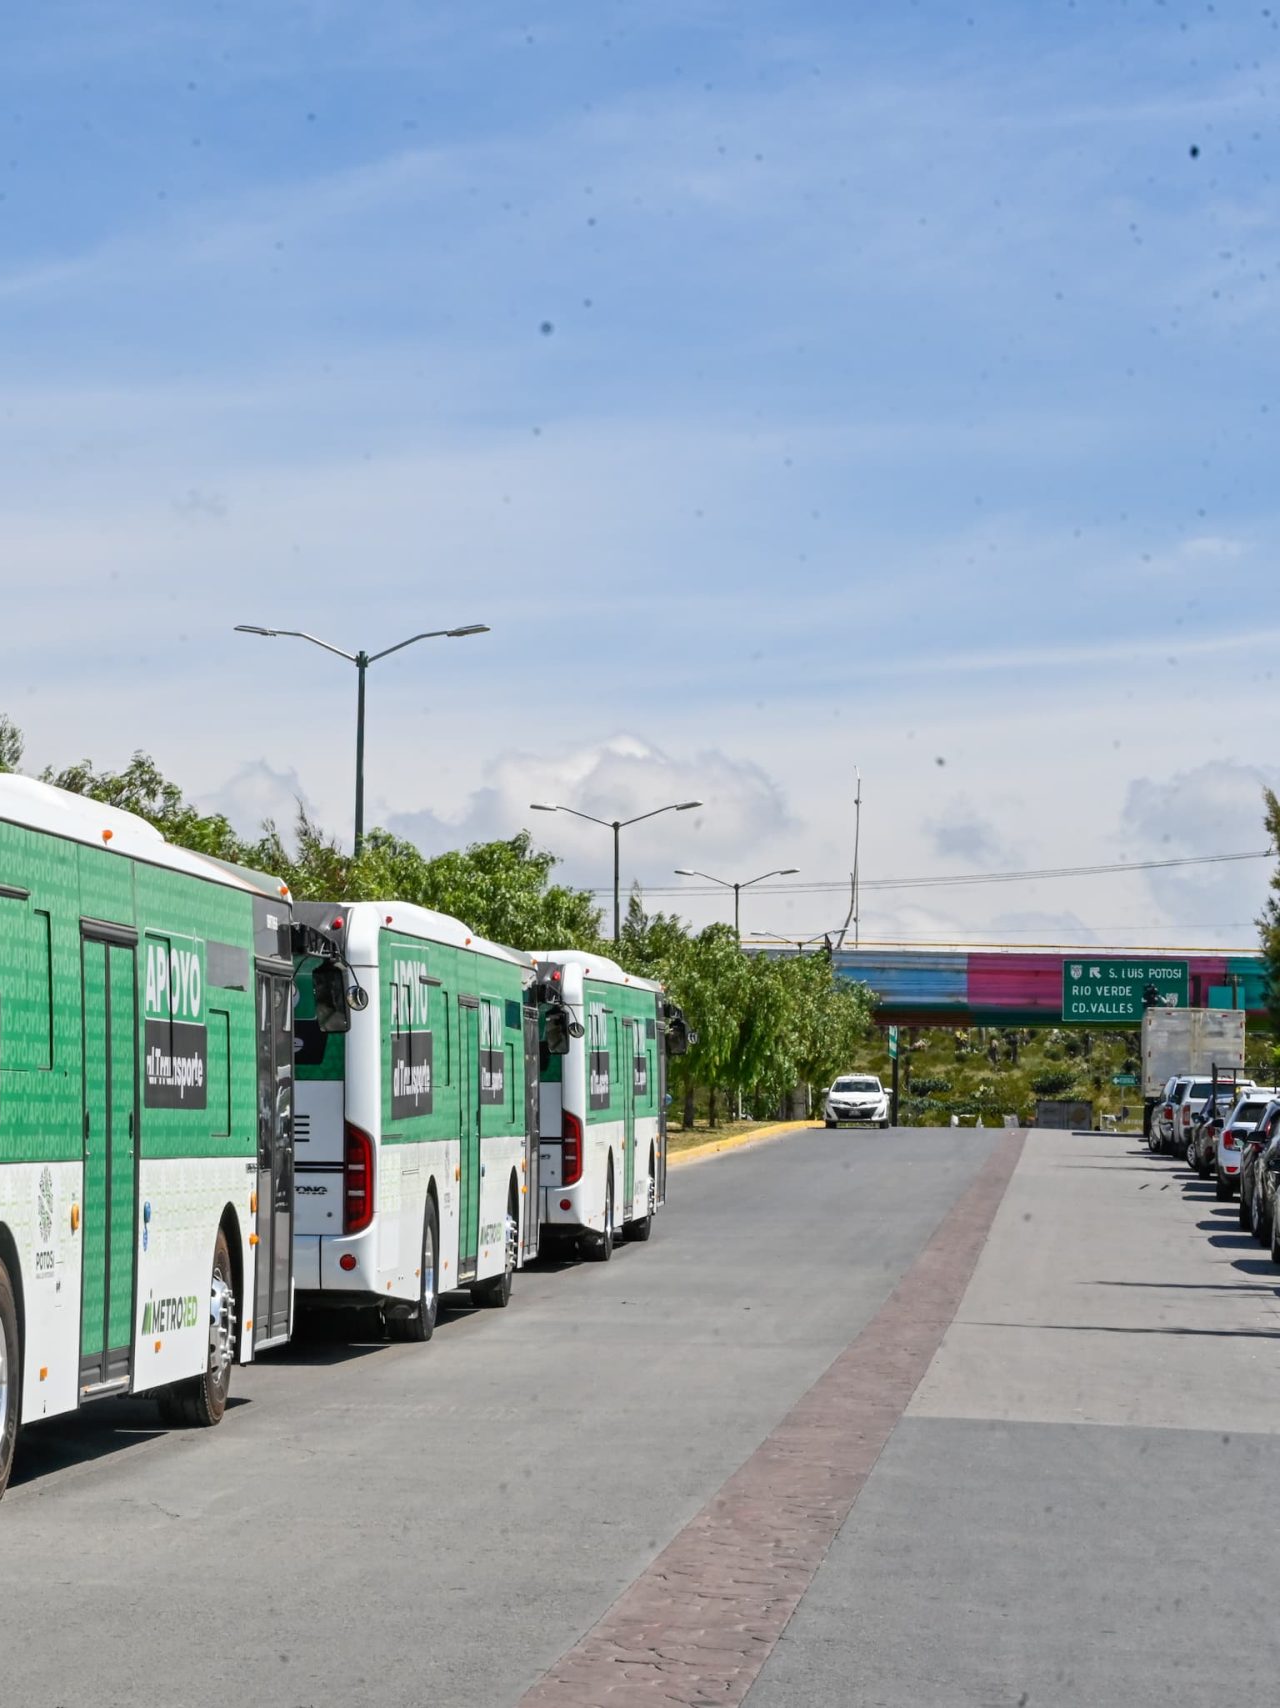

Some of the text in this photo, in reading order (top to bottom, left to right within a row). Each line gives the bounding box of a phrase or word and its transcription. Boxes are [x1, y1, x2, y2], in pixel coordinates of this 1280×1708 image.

[1108, 968, 1118, 978] S.
[146, 944, 200, 1018] APOYO
[1072, 985, 1133, 997] RIO VERDE
